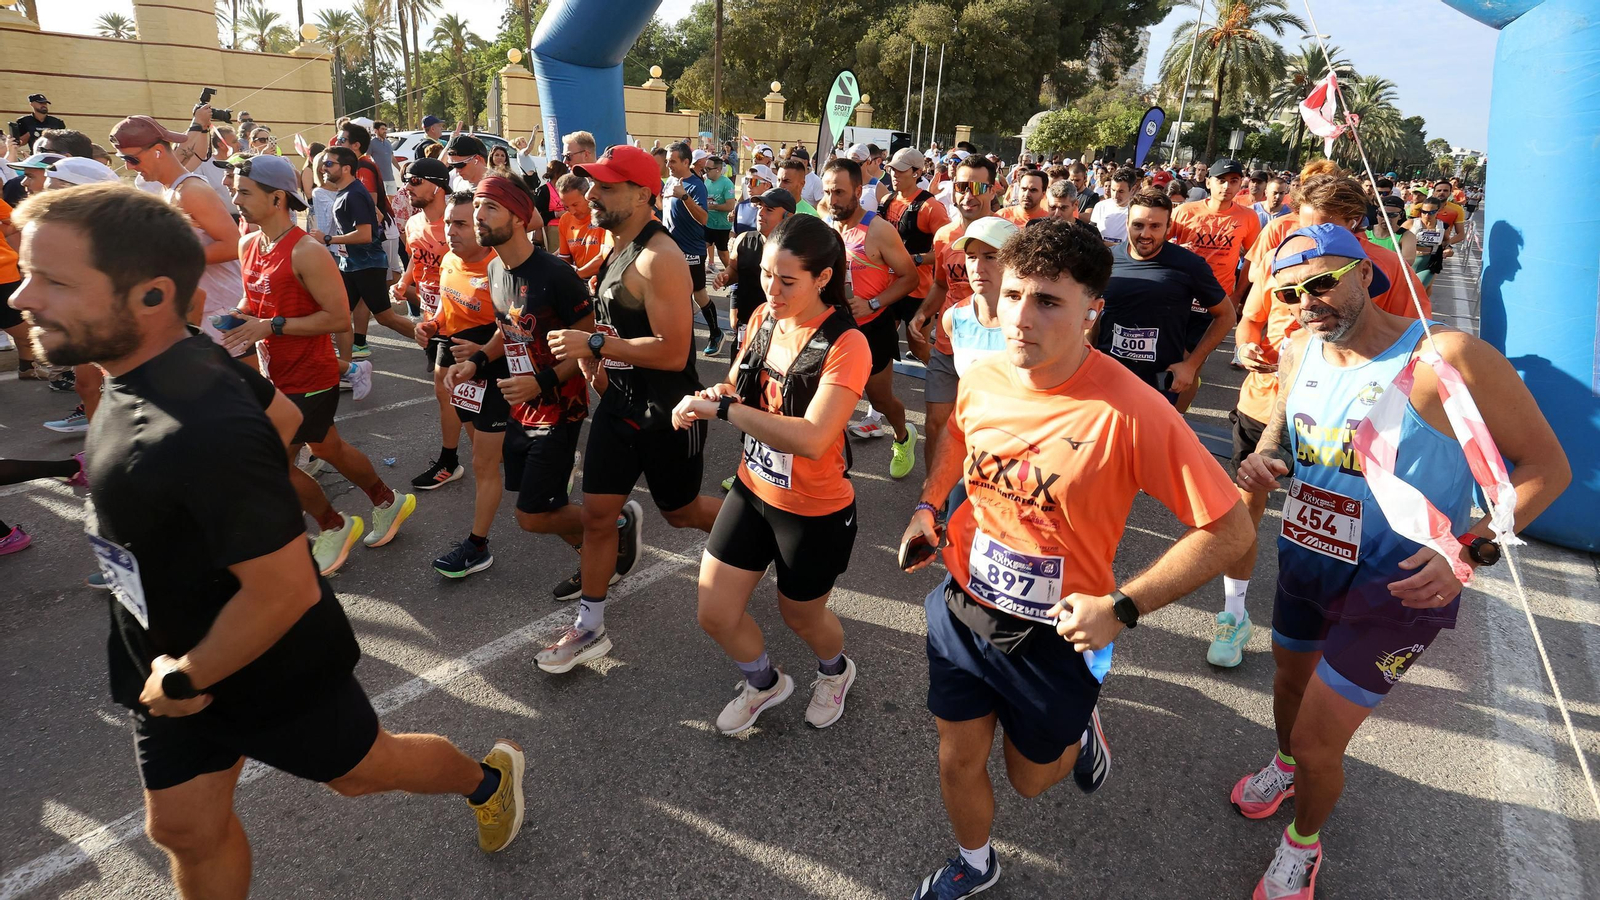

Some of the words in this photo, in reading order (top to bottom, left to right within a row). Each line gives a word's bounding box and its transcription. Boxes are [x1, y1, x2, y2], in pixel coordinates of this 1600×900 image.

[834, 105, 851, 113] SPORT
[1121, 338, 1146, 350] 600
[458, 384, 476, 398] 463
[968, 479, 996, 491] MEDIA
[1297, 504, 1337, 536] 454
[987, 563, 1036, 597] 897
[574, 648, 584, 657] ON
